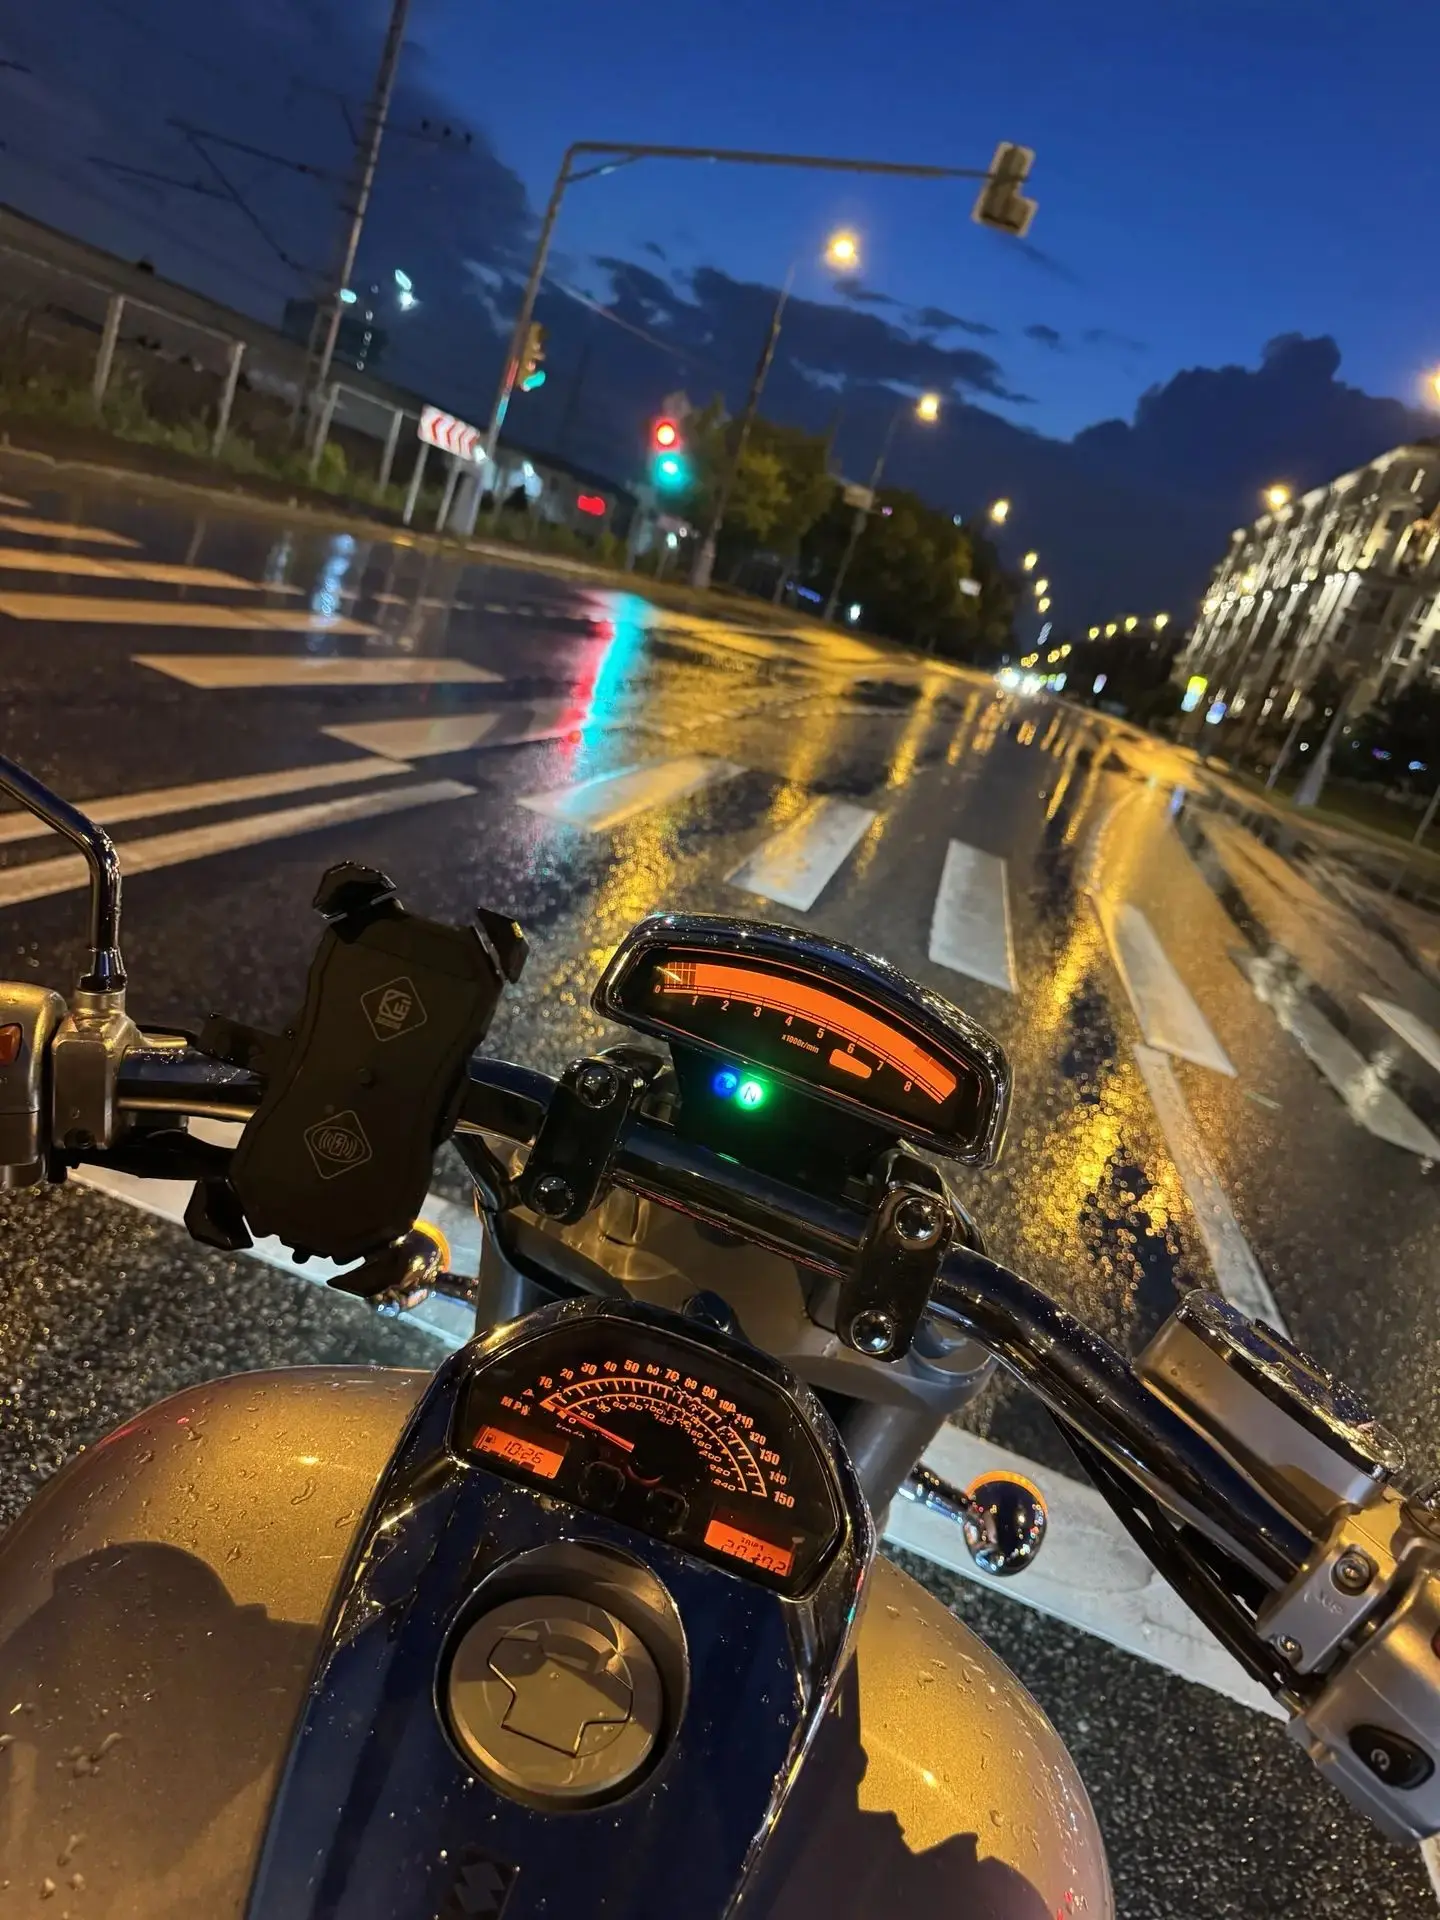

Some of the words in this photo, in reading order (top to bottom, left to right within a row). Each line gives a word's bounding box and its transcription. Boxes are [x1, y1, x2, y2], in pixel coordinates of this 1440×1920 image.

[653, 985, 661, 993] 0
[692, 995, 699, 1006] 1
[721, 1000, 730, 1011] 2
[753, 1006, 762, 1017] 3
[785, 1015, 793, 1026] 4
[816, 1028, 825, 1039] 5
[847, 1043, 856, 1054] 6
[876, 1060, 884, 1071] 7
[904, 1081, 912, 1092] 8
[580, 1362, 597, 1375] 30
[603, 1361, 617, 1372] 40
[624, 1359, 640, 1373] 50
[560, 1368, 574, 1380] 20
[665, 1368, 680, 1382] 70
[539, 1376, 553, 1389] 10
[684, 1377, 698, 1390] 80
[701, 1385, 717, 1400] 90
[612, 1401, 627, 1410] 60
[644, 1403, 664, 1415] 100
[654, 1413, 674, 1425] 120
[692, 1438, 712, 1450] 180
[749, 1431, 767, 1445] 120
[504, 1440, 545, 1464] 10:26
[698, 1450, 722, 1462] 200
[759, 1448, 780, 1466] 130
[709, 1464, 731, 1477] 220
[769, 1470, 787, 1485] 140
[713, 1478, 736, 1491] 240
[773, 1490, 795, 1508] 150
